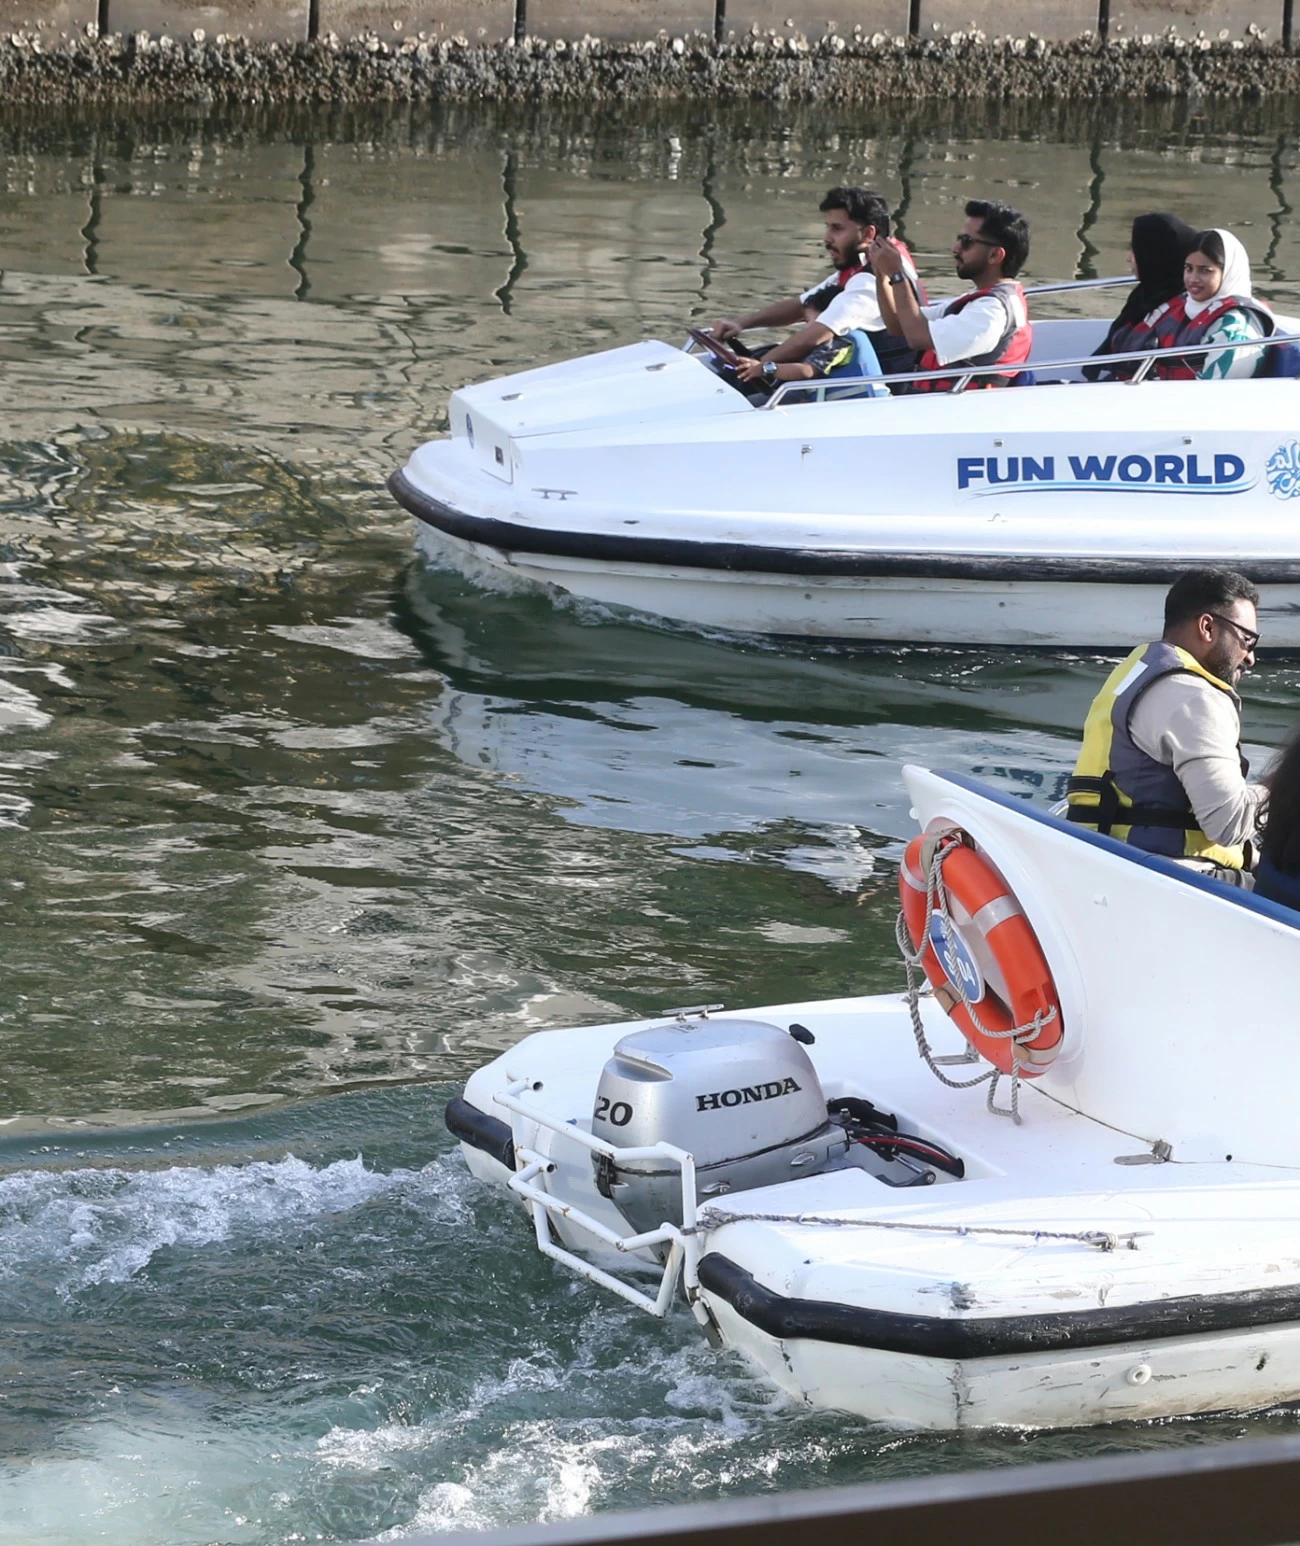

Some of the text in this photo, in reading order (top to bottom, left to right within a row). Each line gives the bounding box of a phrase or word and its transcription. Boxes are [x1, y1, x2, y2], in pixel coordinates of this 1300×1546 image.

[957, 454, 1245, 490] FUN WORLD
[594, 1096, 634, 1127] 20
[696, 1077, 802, 1112] HONDA
